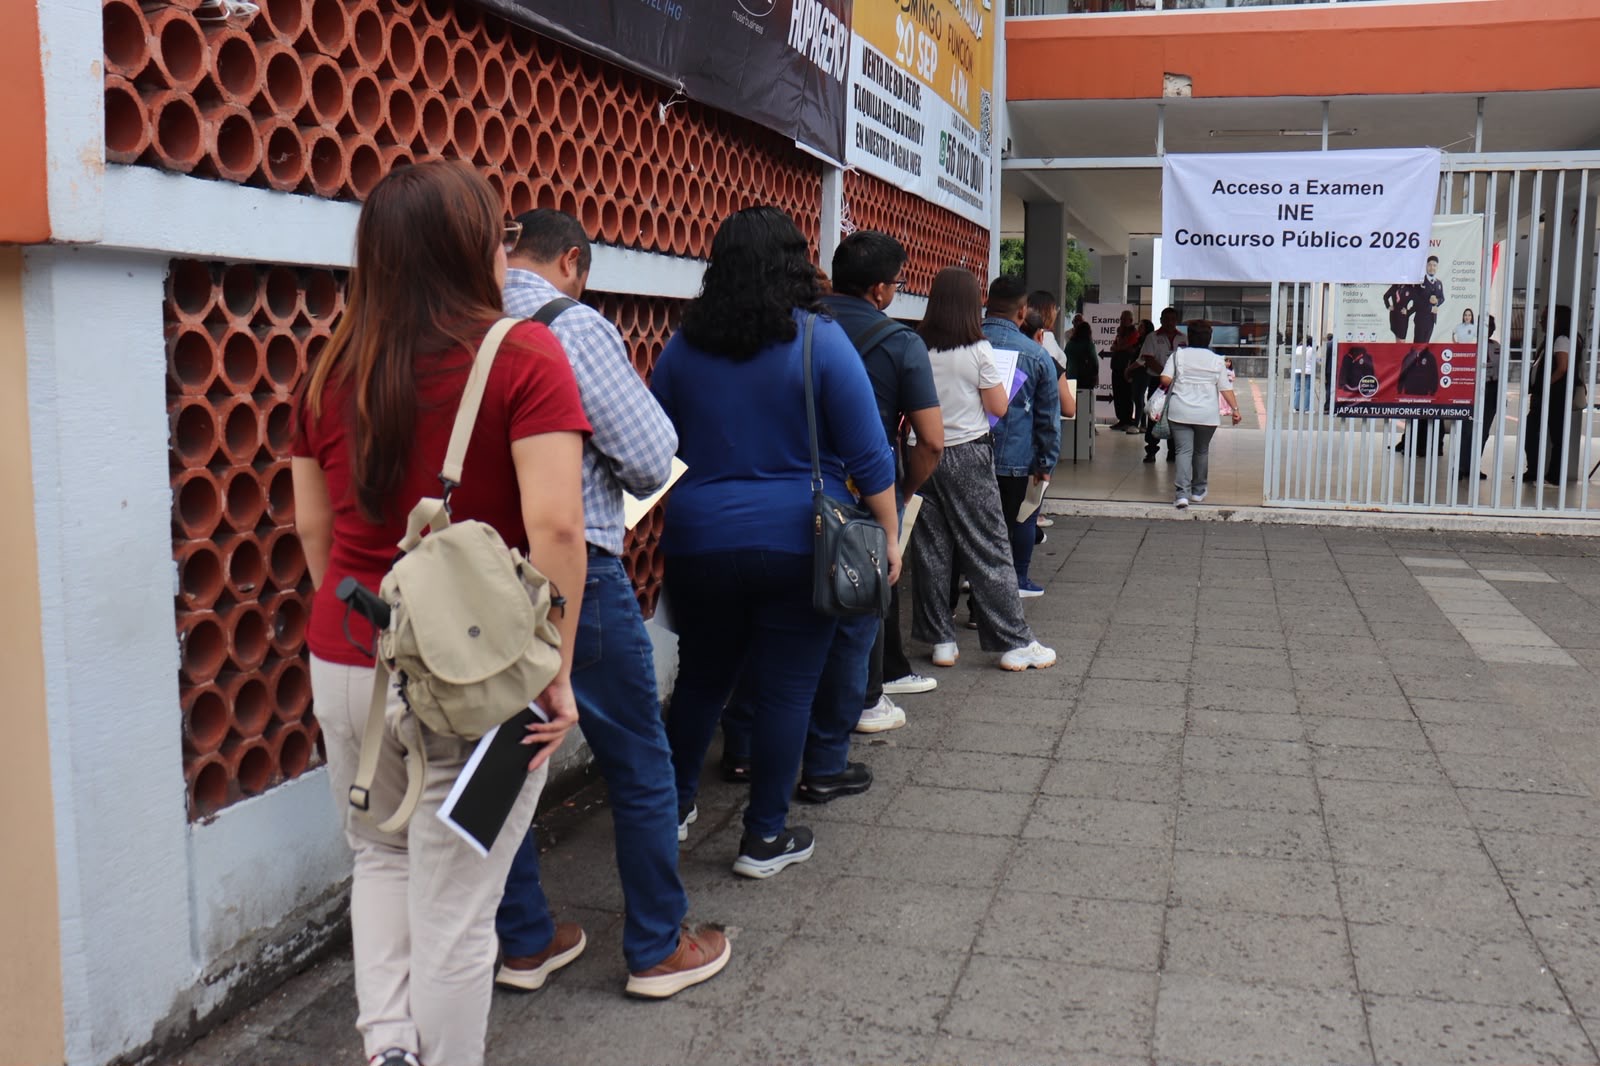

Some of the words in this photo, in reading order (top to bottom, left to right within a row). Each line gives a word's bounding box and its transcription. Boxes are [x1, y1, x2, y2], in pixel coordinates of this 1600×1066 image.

[895, 14, 915, 68] 20
[917, 31, 938, 83] SEP
[862, 45, 883, 87] VENTA
[884, 61, 892, 93] DE
[950, 64, 957, 102] 4
[854, 83, 882, 125] TAQUILLA
[882, 101, 892, 129] DEL
[856, 122, 863, 150] EN
[864, 126, 890, 163] NUESTRA
[1212, 179, 1283, 195] Acceso
[1289, 183, 1300, 195] a
[1306, 179, 1384, 196] Examen
[1277, 204, 1314, 221] INE
[1174, 228, 1275, 247] Concurso
[1281, 229, 1363, 249] Público
[1369, 231, 1420, 249] 2026
[1092, 315, 1120, 324] Exame
[1101, 326, 1116, 334] INE
[1371, 407, 1381, 415] TU
[1382, 407, 1420, 416] UNIFORME
[1422, 408, 1440, 416] HOY
[1441, 408, 1470, 417] MISMO!
